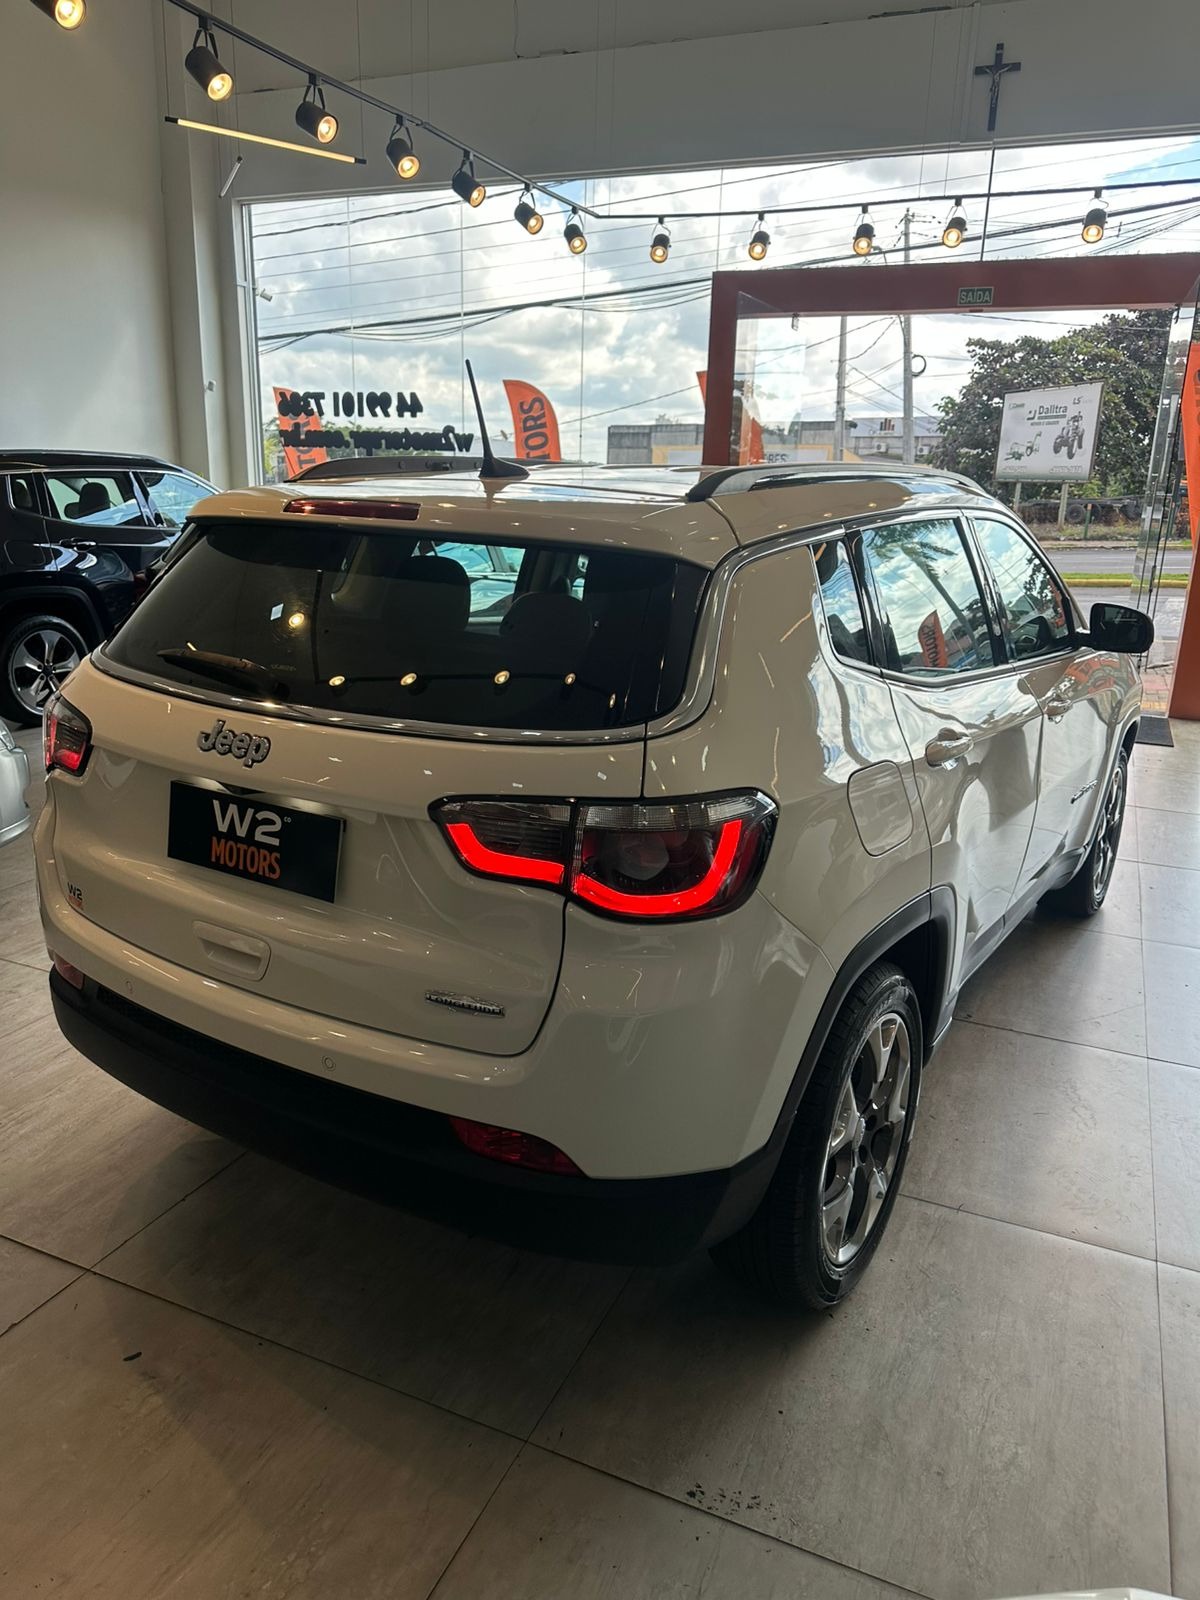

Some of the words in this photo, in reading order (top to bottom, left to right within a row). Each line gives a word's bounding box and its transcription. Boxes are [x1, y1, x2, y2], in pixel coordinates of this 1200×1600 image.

[960, 288, 991, 303] SAÍDA
[198, 719, 271, 768] Jeep
[213, 799, 282, 846] W2
[210, 836, 281, 880] MOTORS
[67, 881, 83, 901] W2
